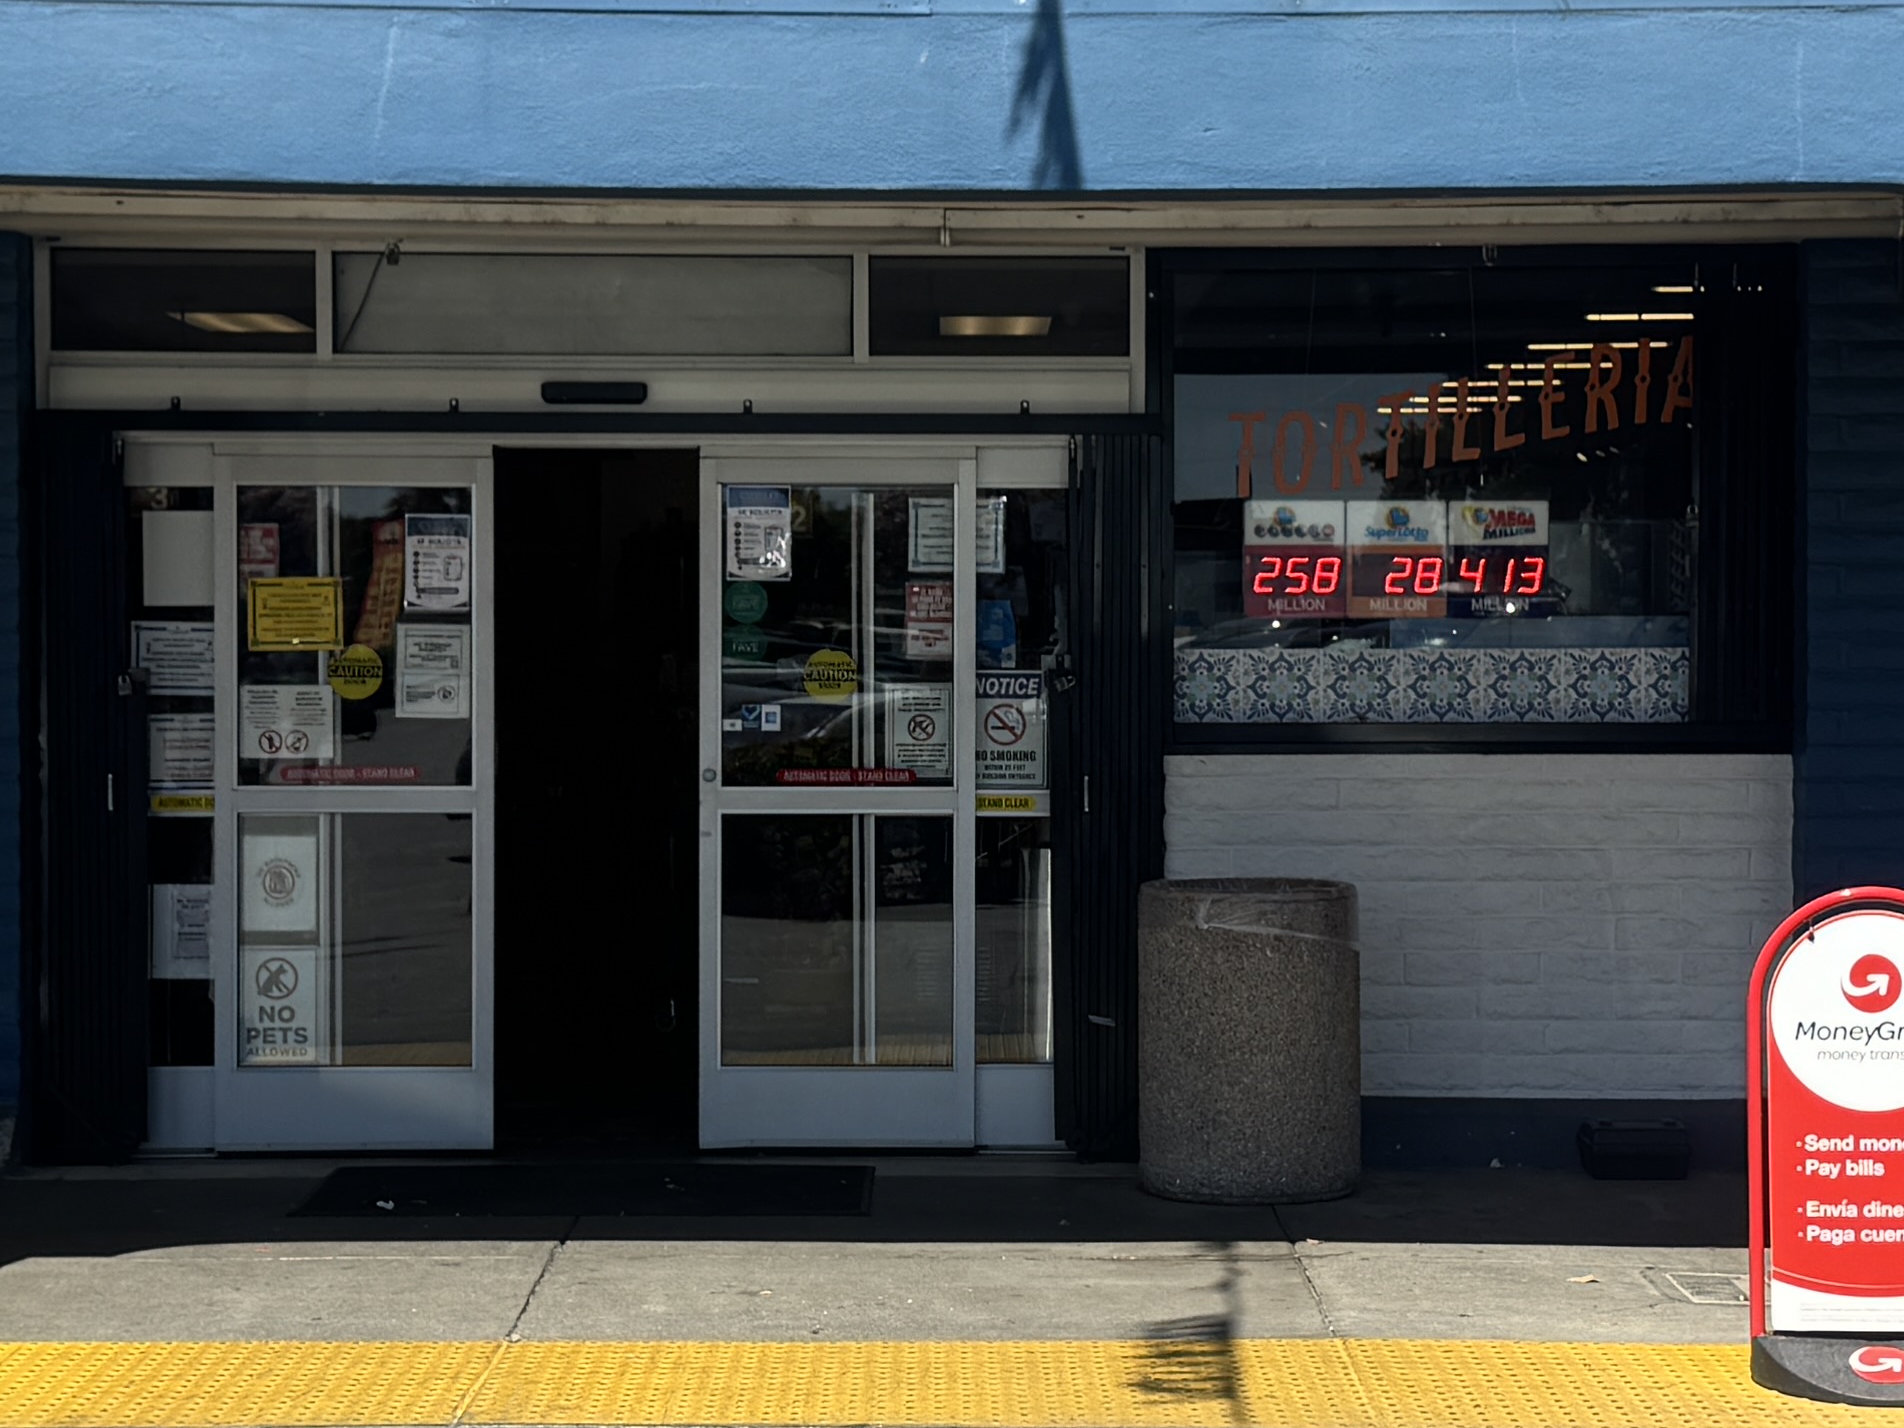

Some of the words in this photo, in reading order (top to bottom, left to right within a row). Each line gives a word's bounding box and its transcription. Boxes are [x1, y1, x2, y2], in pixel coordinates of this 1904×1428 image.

[1227, 336, 1694, 499] TORTILLERIA
[1252, 556, 1343, 595] 258
[1384, 556, 1444, 595] 28
[1268, 599, 1326, 612] MILLION
[1370, 599, 1428, 612] MILLION
[328, 666, 383, 677] CAUTION
[805, 670, 856, 681] CAUTION
[989, 750, 1037, 762] SMOKING
[259, 1005, 296, 1024] NO
[247, 1027, 309, 1044] PETS
[246, 1046, 308, 1057] ALLOWED
[1816, 1049, 1867, 1064] money
[1804, 1134, 1855, 1152] Send
[1805, 1159, 1842, 1179] Pay
[1845, 1158, 1886, 1177] bills
[1806, 1198, 1858, 1218] Envía
[1806, 1224, 1856, 1246] Paga
